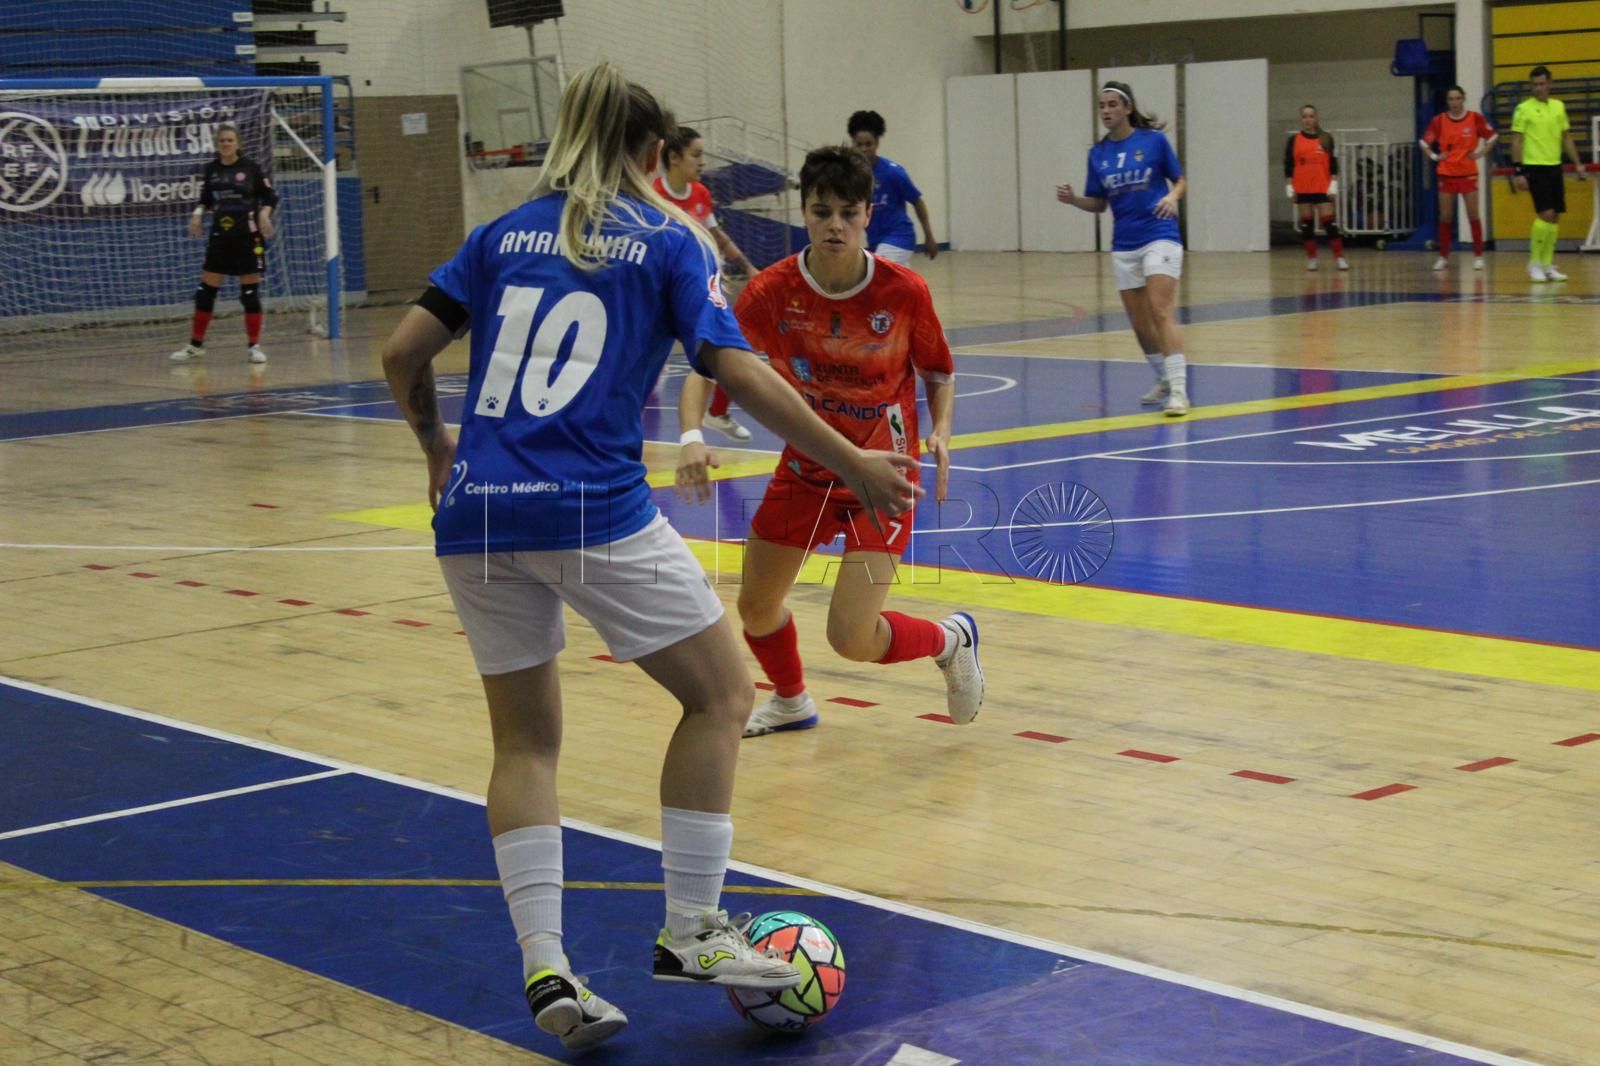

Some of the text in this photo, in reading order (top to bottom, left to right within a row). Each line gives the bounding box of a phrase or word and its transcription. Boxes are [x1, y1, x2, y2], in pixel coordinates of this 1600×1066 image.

[474, 284, 608, 418] 10
[464, 482, 509, 495] Centro
[511, 481, 560, 494] Médico
[886, 521, 902, 545] 7
